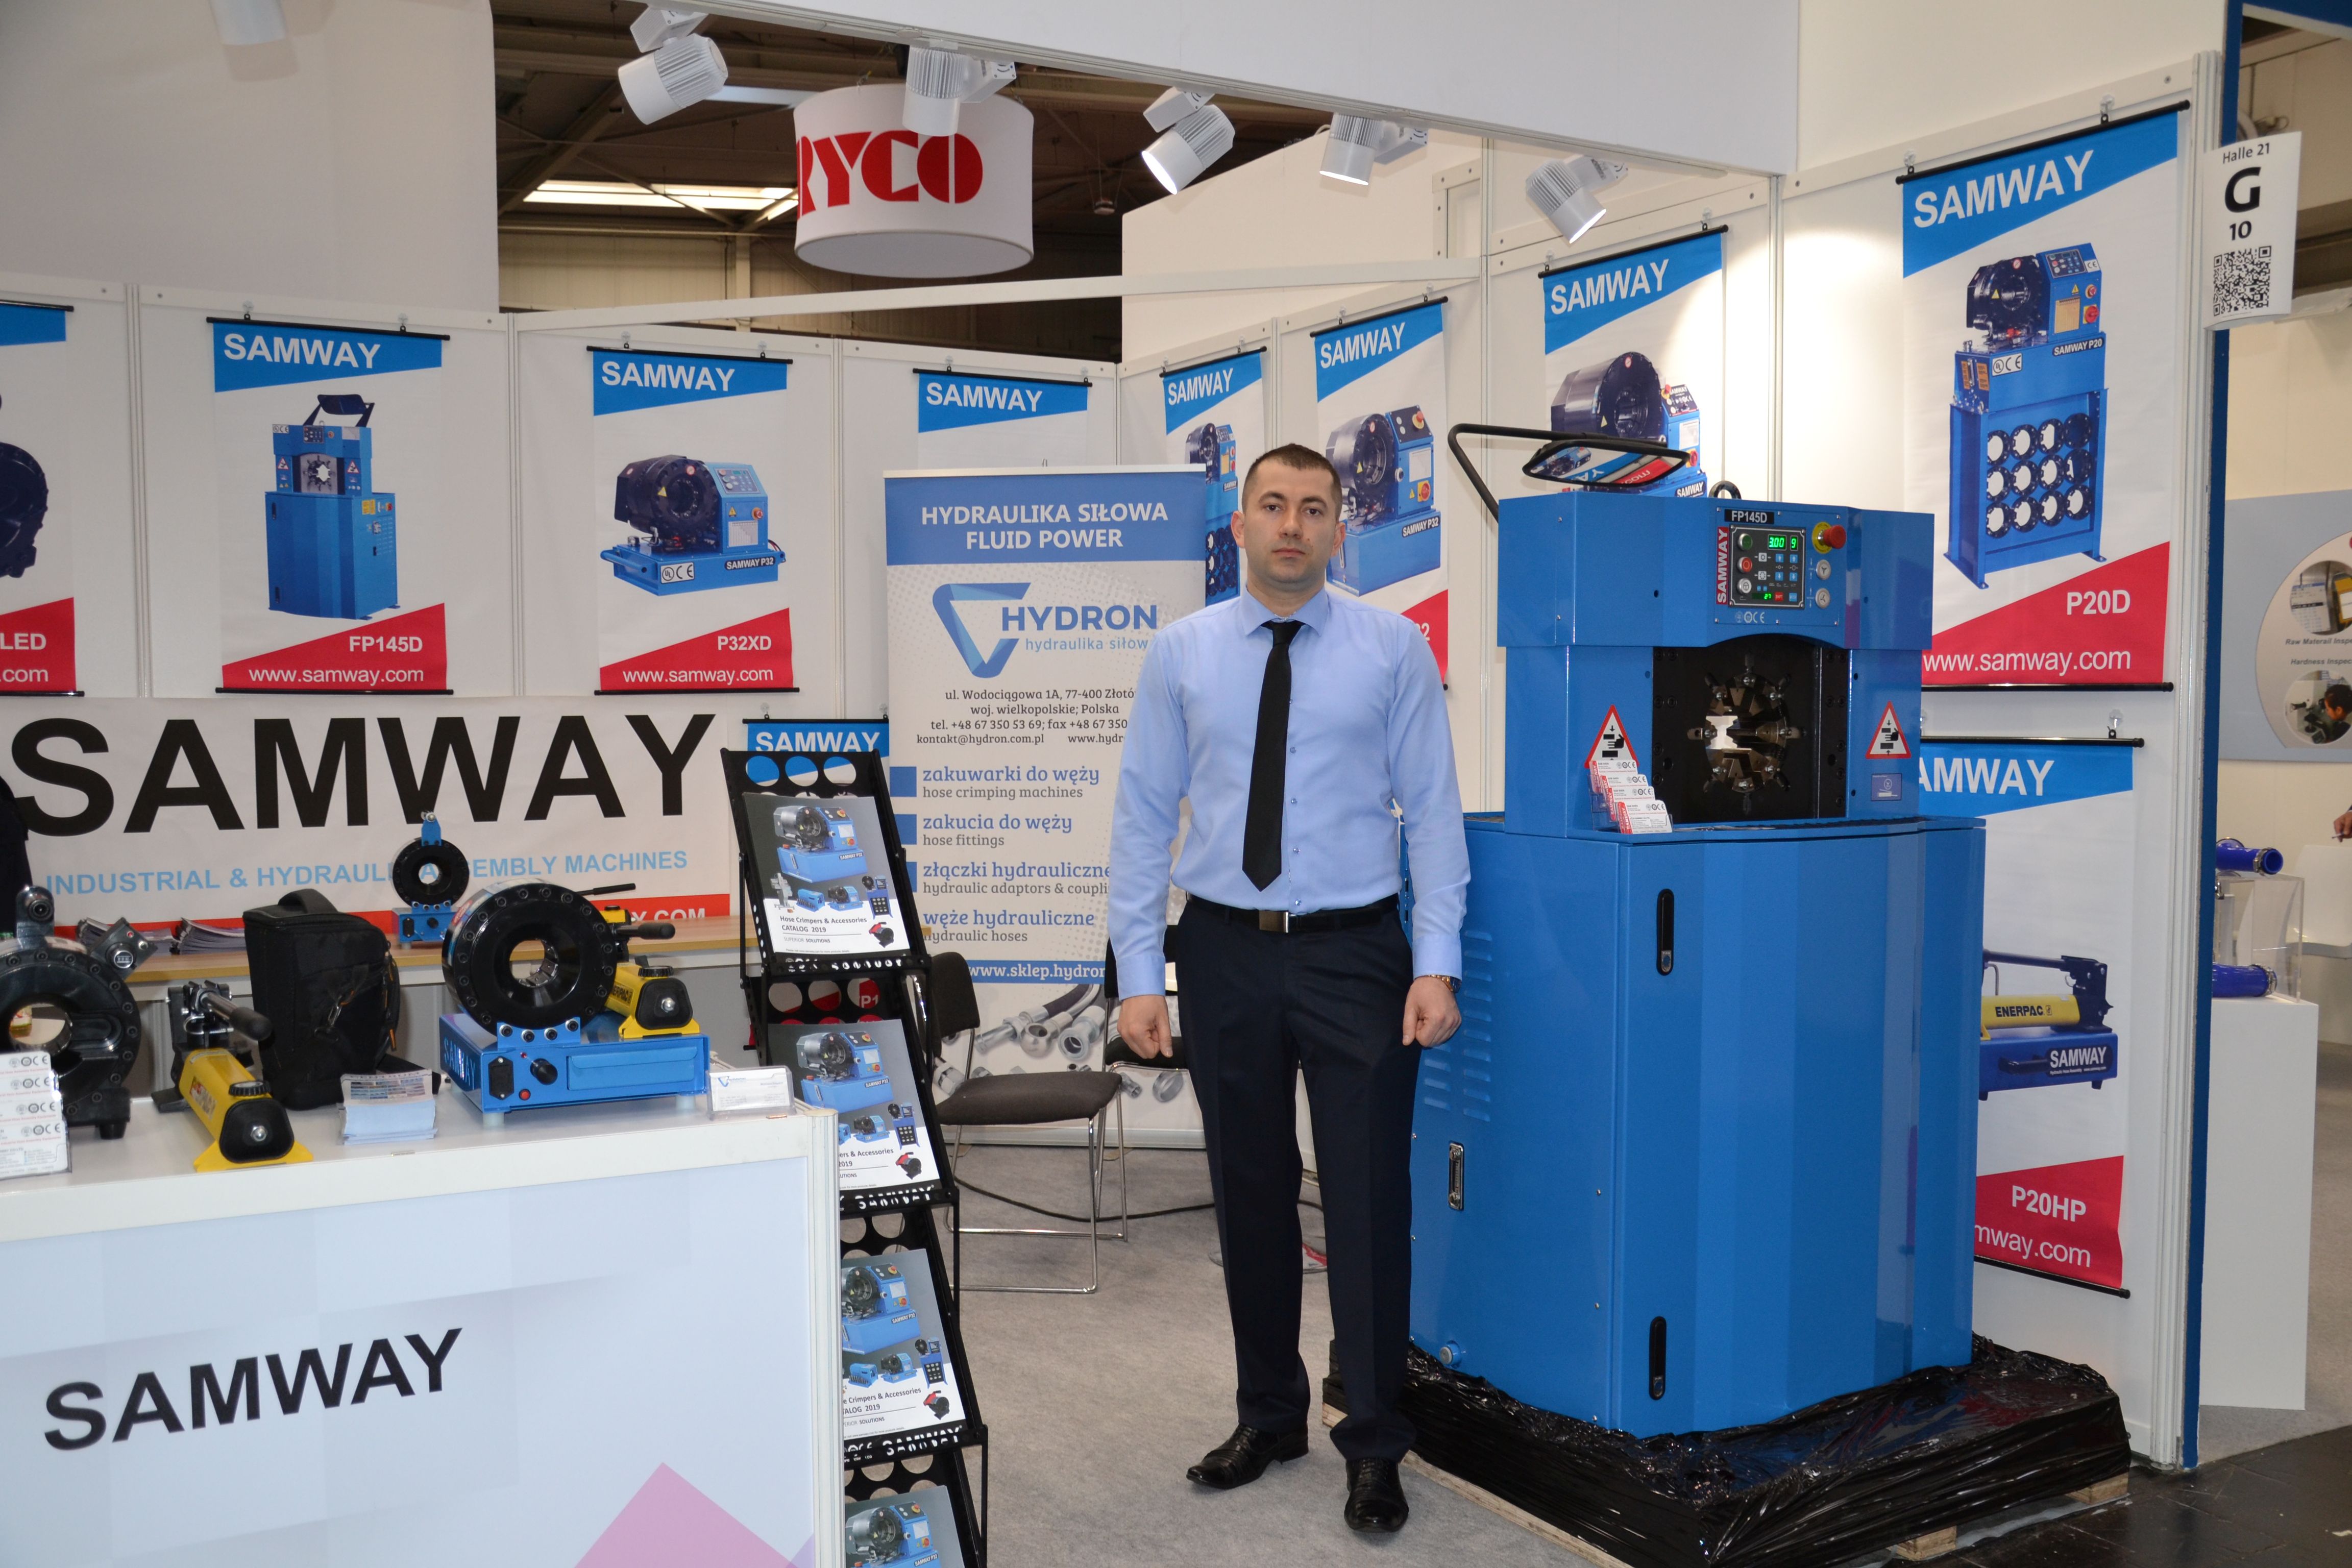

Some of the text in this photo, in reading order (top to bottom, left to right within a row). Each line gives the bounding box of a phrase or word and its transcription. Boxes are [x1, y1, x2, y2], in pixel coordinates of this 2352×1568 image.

[2223, 142, 2270, 164] Halle 21
[1914, 150, 2094, 228] SAMWAY
[2225, 166, 2262, 213] G
[2230, 220, 2252, 241] 10
[1551, 259, 1669, 315] SAMWAY
[224, 333, 380, 369] SAMWAY
[1320, 323, 1406, 369] SAMWAY
[2053, 338, 2102, 356] SAMWAY P20
[601, 361, 735, 392] SAMWAY
[926, 382, 1042, 412] SAMWAY
[1168, 368, 1234, 406] SAMWAY
[1677, 482, 1704, 497] SAMWAY
[922, 503, 1168, 525] HYDRAULIKA SIŁOWA
[1731, 510, 1768, 523] FP145D
[1403, 517, 1439, 537] SAMWAY P32
[967, 529, 1123, 549] FLUID POWER
[726, 557, 774, 570] SAMWAY P32
[1717, 529, 1729, 603] SAMWAY
[2067, 590, 2130, 616] P20D
[1002, 605, 1157, 631] HYDRON
[350, 636, 423, 653] FP145D
[718, 635, 772, 651] P32XD
[1026, 637, 1148, 652] hydraulika siłow
[1923, 651, 2131, 677] www.samway.com
[249, 667, 424, 688] www.samway.com
[623, 667, 773, 685] www.samway.com
[945, 687, 1135, 702] ul. Wodociągowa 1A, 77-400 Złotó
[971, 703, 1119, 717] woj. wielkopolskie; Polska
[931, 719, 1128, 730] tel. +48 67 350 53 69; fax +48 67 350
[755, 731, 880, 752] SAMWAY
[917, 733, 1124, 745] kontakt@hydron.com.pl www.hydr
[12, 714, 716, 837] SAMWAY
[923, 765, 1099, 785] zakuwarki do węży
[1919, 757, 2054, 796] AMWAY
[923, 787, 1083, 800] hose crimping machines
[923, 814, 1072, 834] zakucia do węży
[923, 834, 1004, 848] hose fittings
[46, 850, 688, 896] INDUSTRIAL & HYDRAULI AEMBLY MACHINES
[923, 862, 1110, 881] złączki hydrauliczne
[923, 882, 1108, 896] hydraulic adaptors & coupli
[796, 917, 823, 926] Crimpers
[923, 910, 1094, 929] węże hydrauliczne
[992, 930, 1028, 942] hoses
[1995, 1005, 2044, 1018] ENERPAC
[444, 1037, 475, 1088] SAMWAY
[2050, 1046, 2107, 1068] SAMWAY
[857, 1148, 893, 1157] Accessories
[2012, 1185, 2086, 1222] P20HP
[1974, 1224, 2091, 1267] mway.com
[44, 1328, 462, 1452] SAMWAY
[848, 1394, 876, 1404] Crimpers
[885, 1387, 921, 1399] Accessories
[865, 1404, 880, 1412] 2019
[859, 1416, 885, 1425] SOLUTIONS
